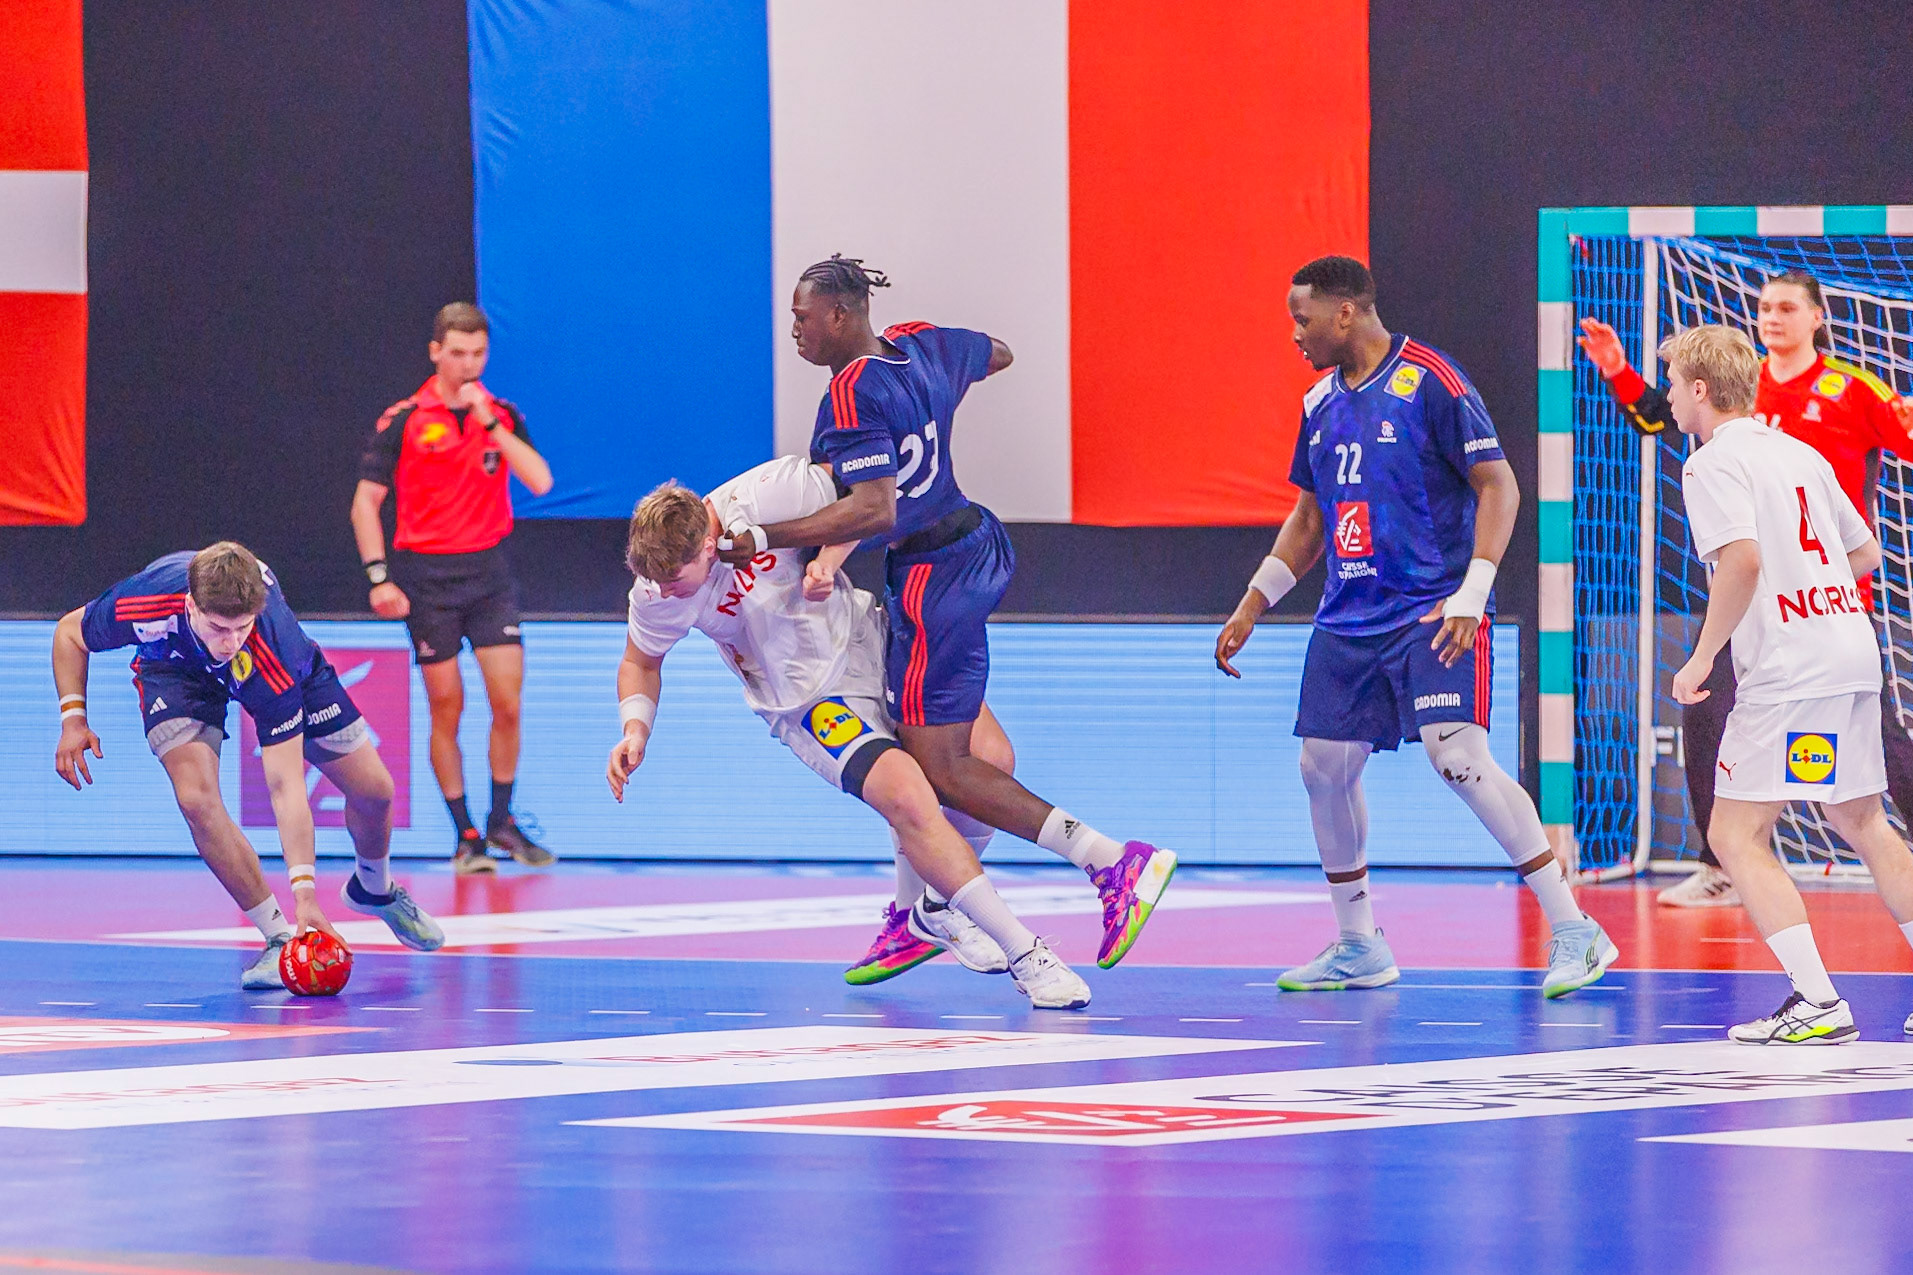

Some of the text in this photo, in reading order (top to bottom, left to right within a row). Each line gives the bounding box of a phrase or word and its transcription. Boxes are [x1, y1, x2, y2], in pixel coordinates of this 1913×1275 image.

[842, 453, 890, 473] ACADOMIA
[1335, 442, 1362, 485] 22
[1795, 486, 1829, 565] 4
[1193, 1066, 1748, 1103] CAISSE
